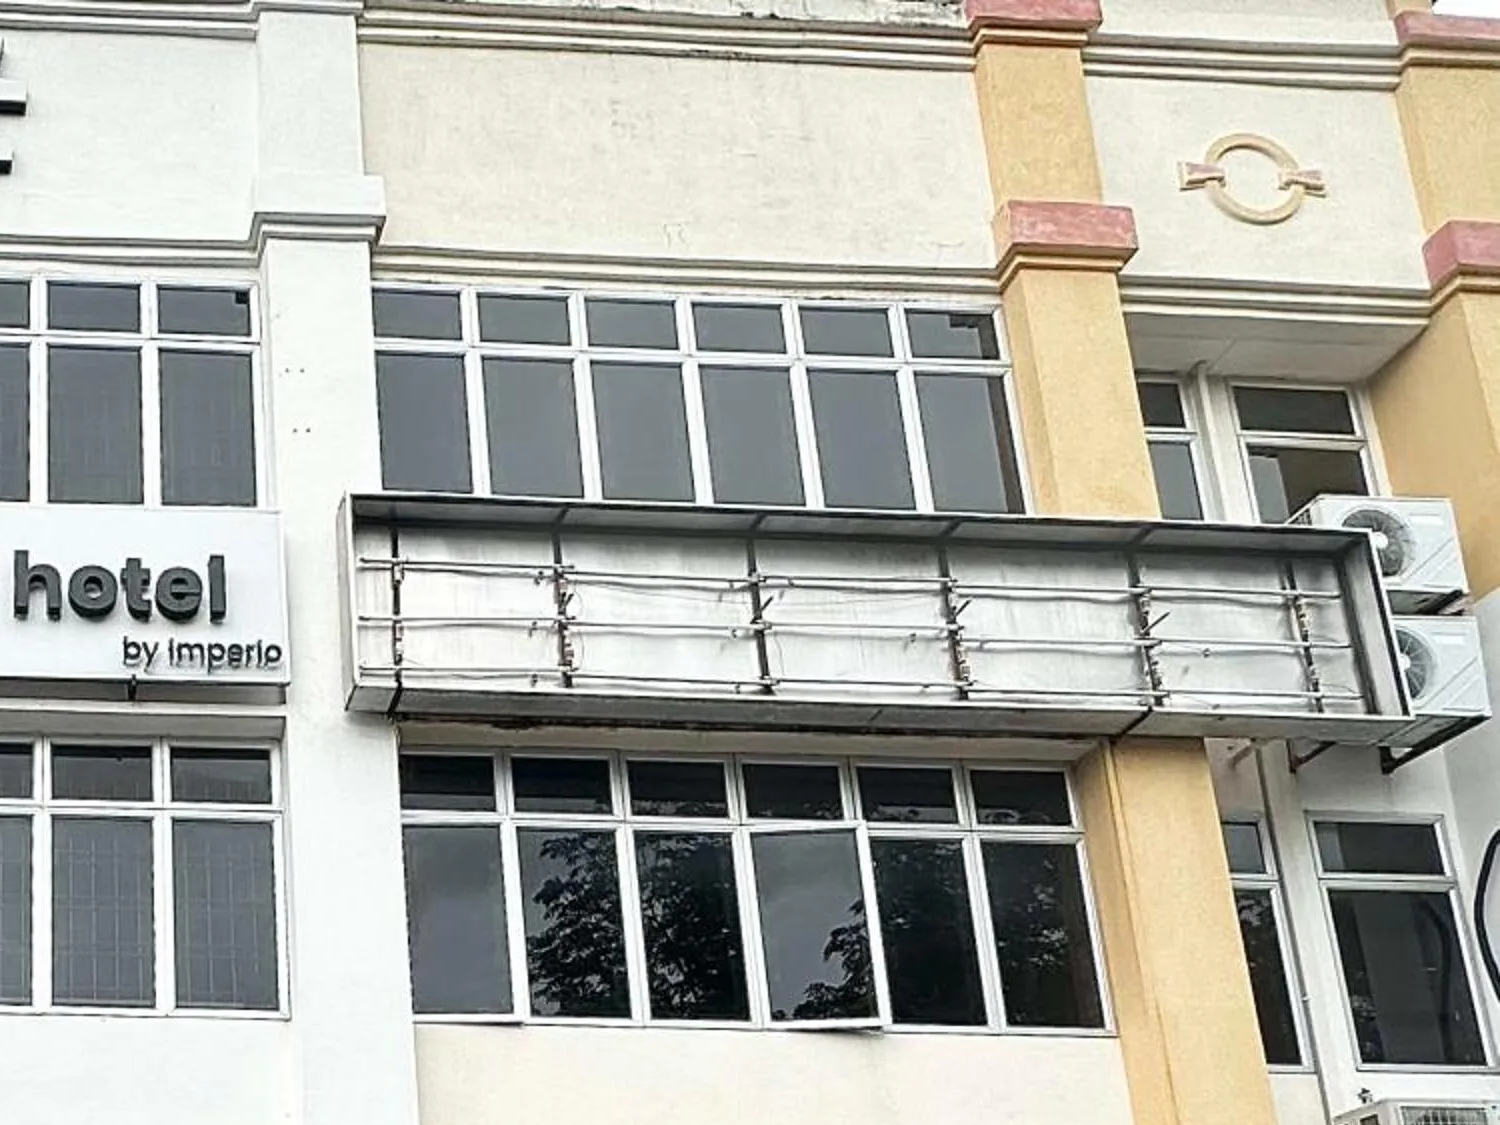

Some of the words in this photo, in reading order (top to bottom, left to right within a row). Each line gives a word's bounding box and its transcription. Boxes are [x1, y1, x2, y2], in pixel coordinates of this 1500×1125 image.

[12, 549, 228, 623] hotel
[122, 635, 159, 675] by
[168, 637, 283, 676] imperio
